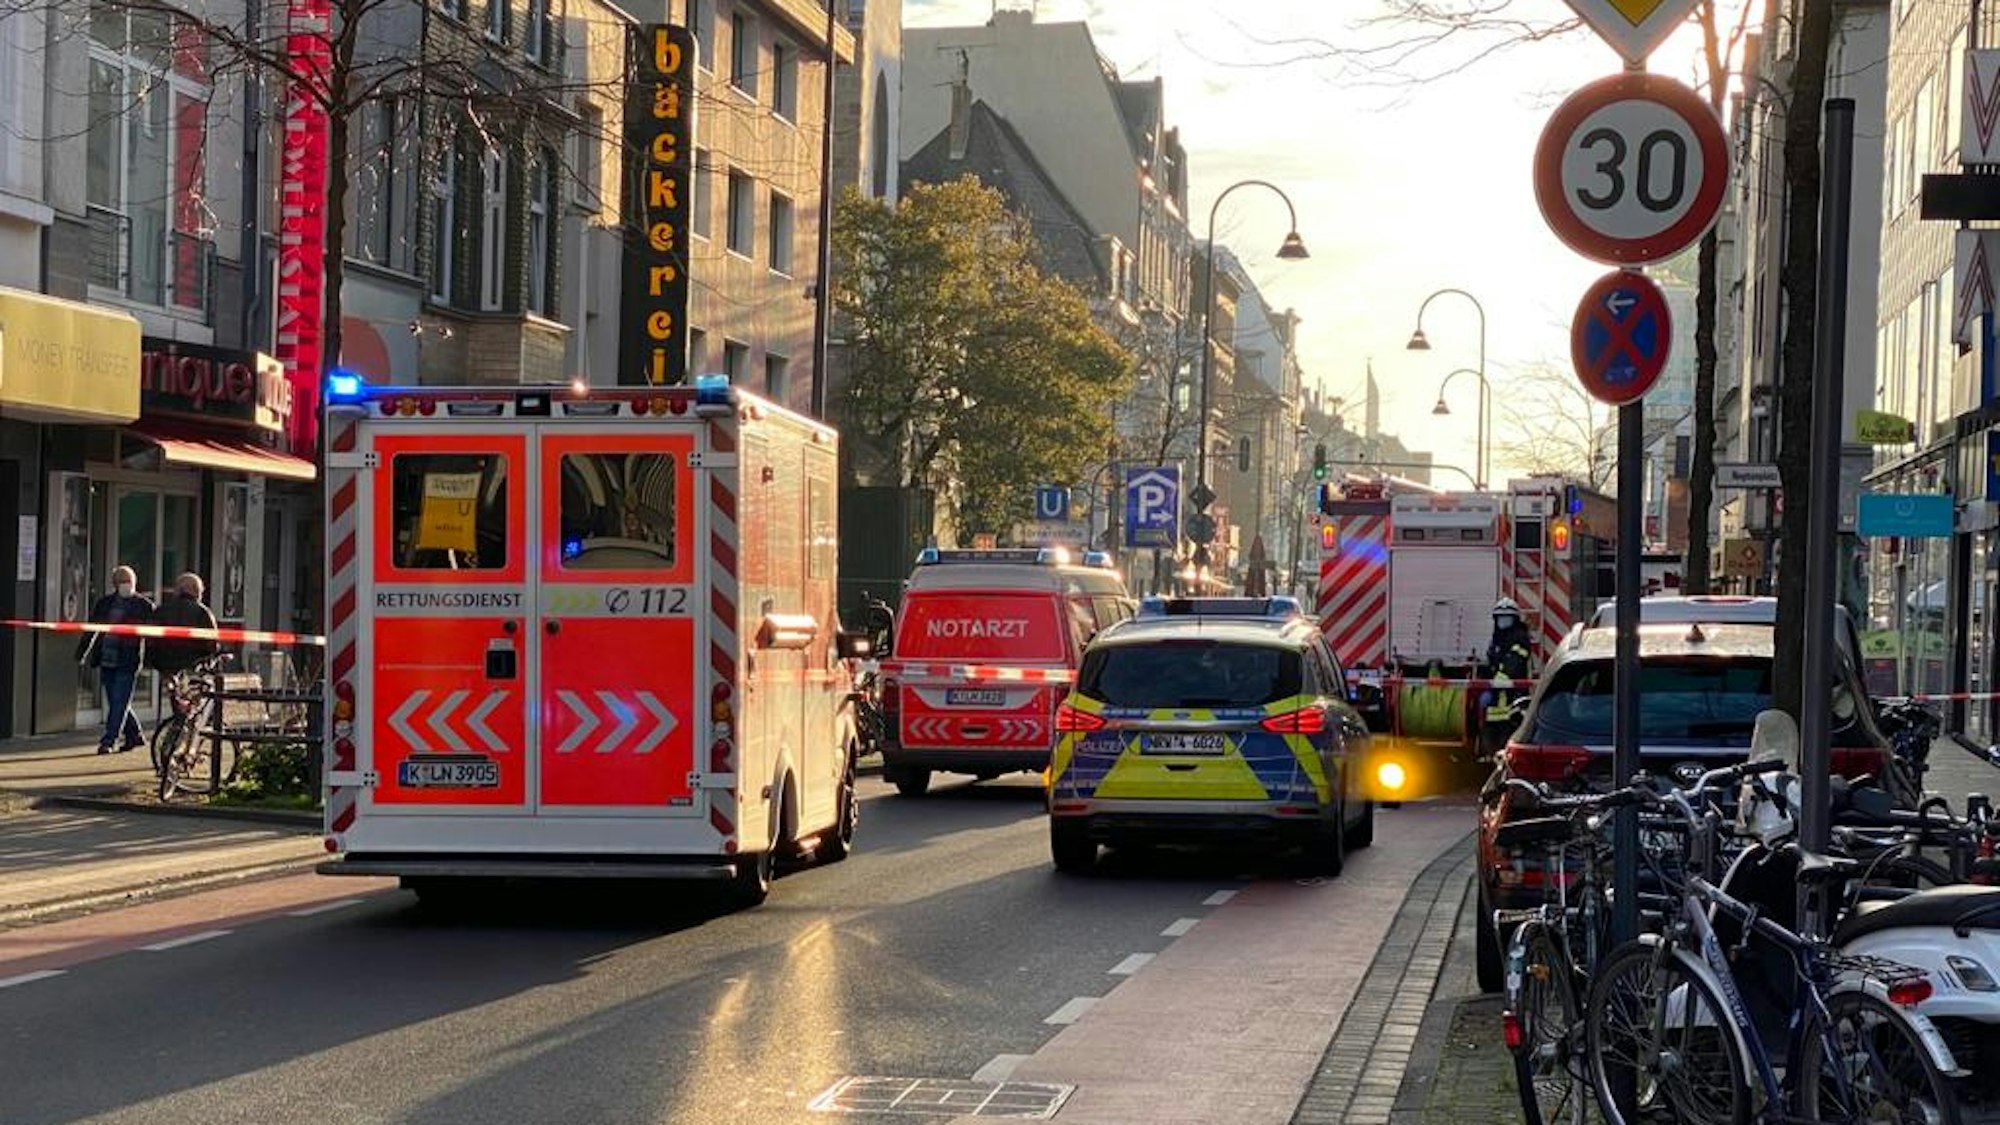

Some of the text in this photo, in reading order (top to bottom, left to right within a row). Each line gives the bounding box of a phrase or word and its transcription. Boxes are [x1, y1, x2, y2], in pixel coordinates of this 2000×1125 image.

[1577, 127, 1687, 213] 30
[647, 28, 681, 384] bäckerei
[18, 338, 63, 368] MONEY
[1042, 491, 1062, 517] U
[1138, 485, 1166, 523] P
[376, 592, 522, 608] RETTUNGSDIENST
[640, 587, 687, 613] 112
[927, 619, 1029, 638] NOTARZT
[410, 765, 496, 782] K LN 3905
